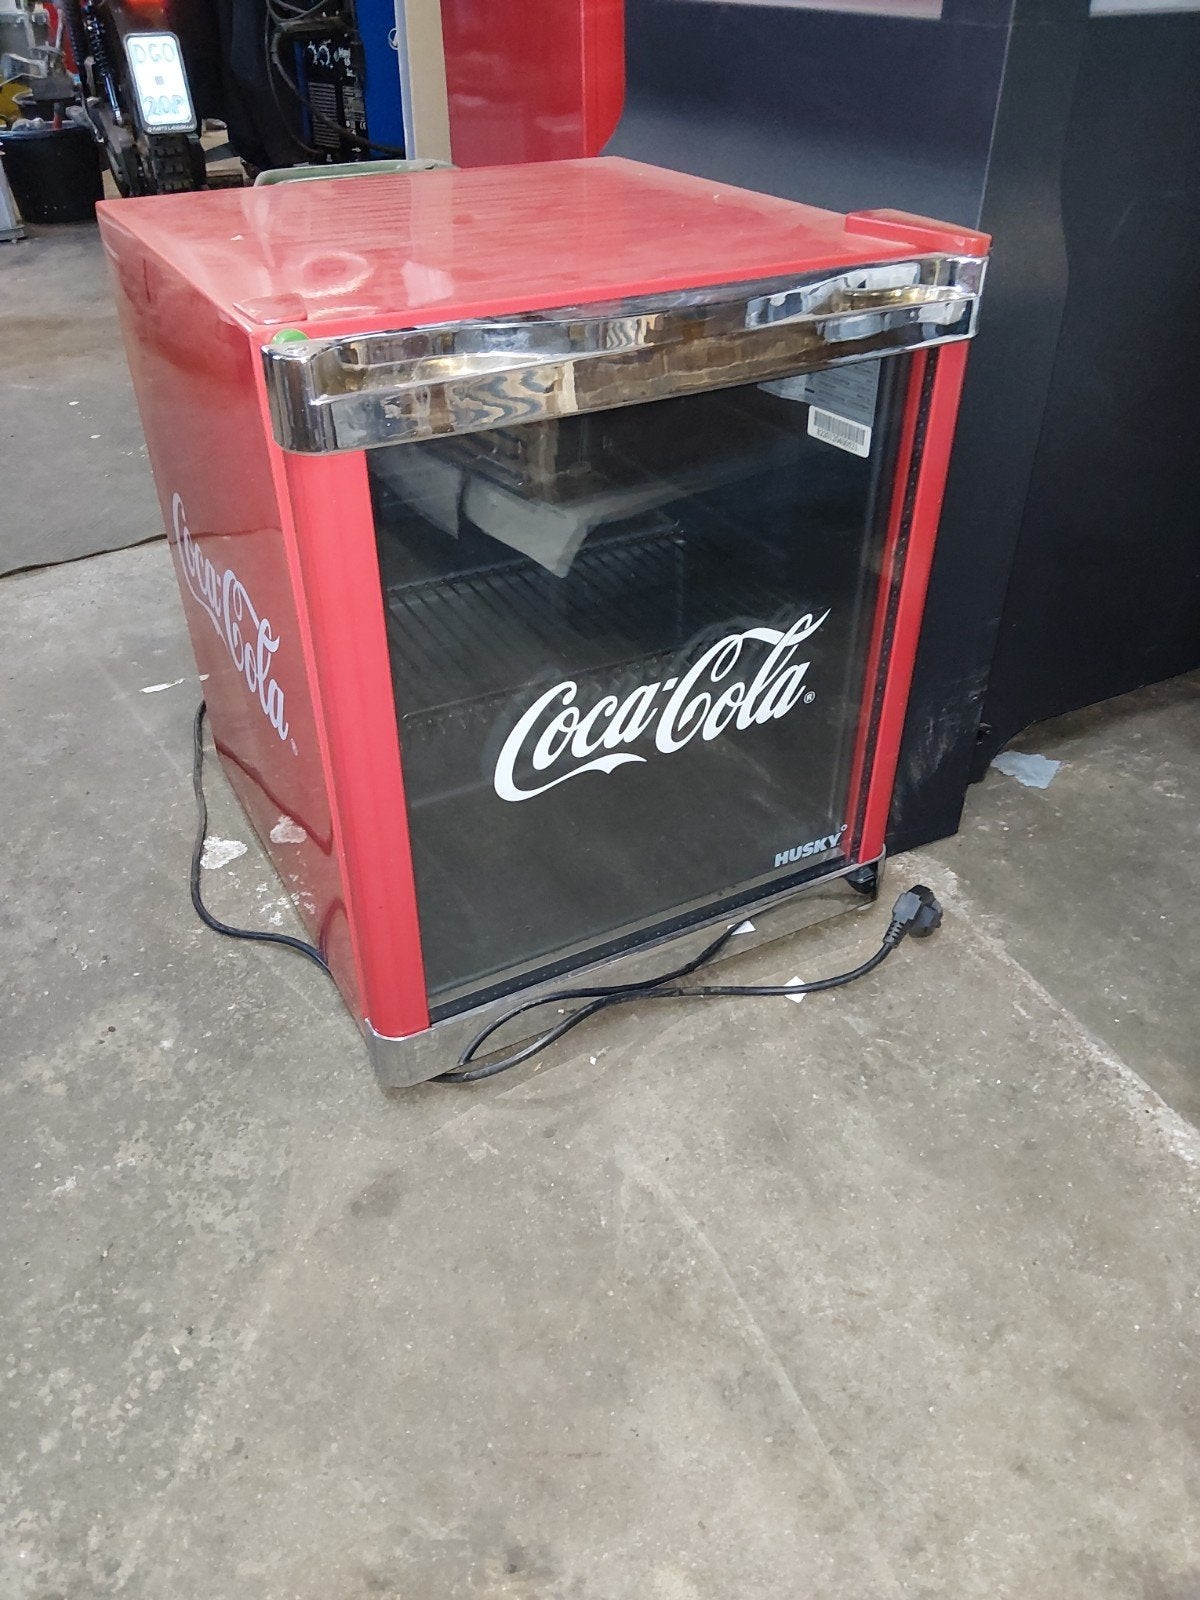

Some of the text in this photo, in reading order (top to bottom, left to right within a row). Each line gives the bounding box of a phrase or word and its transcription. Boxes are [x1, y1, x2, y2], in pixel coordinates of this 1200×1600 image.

[172, 492, 289, 741] Coca-Cola
[493, 608, 832, 802] Coca-Cola
[774, 831, 843, 867] HUSKY
